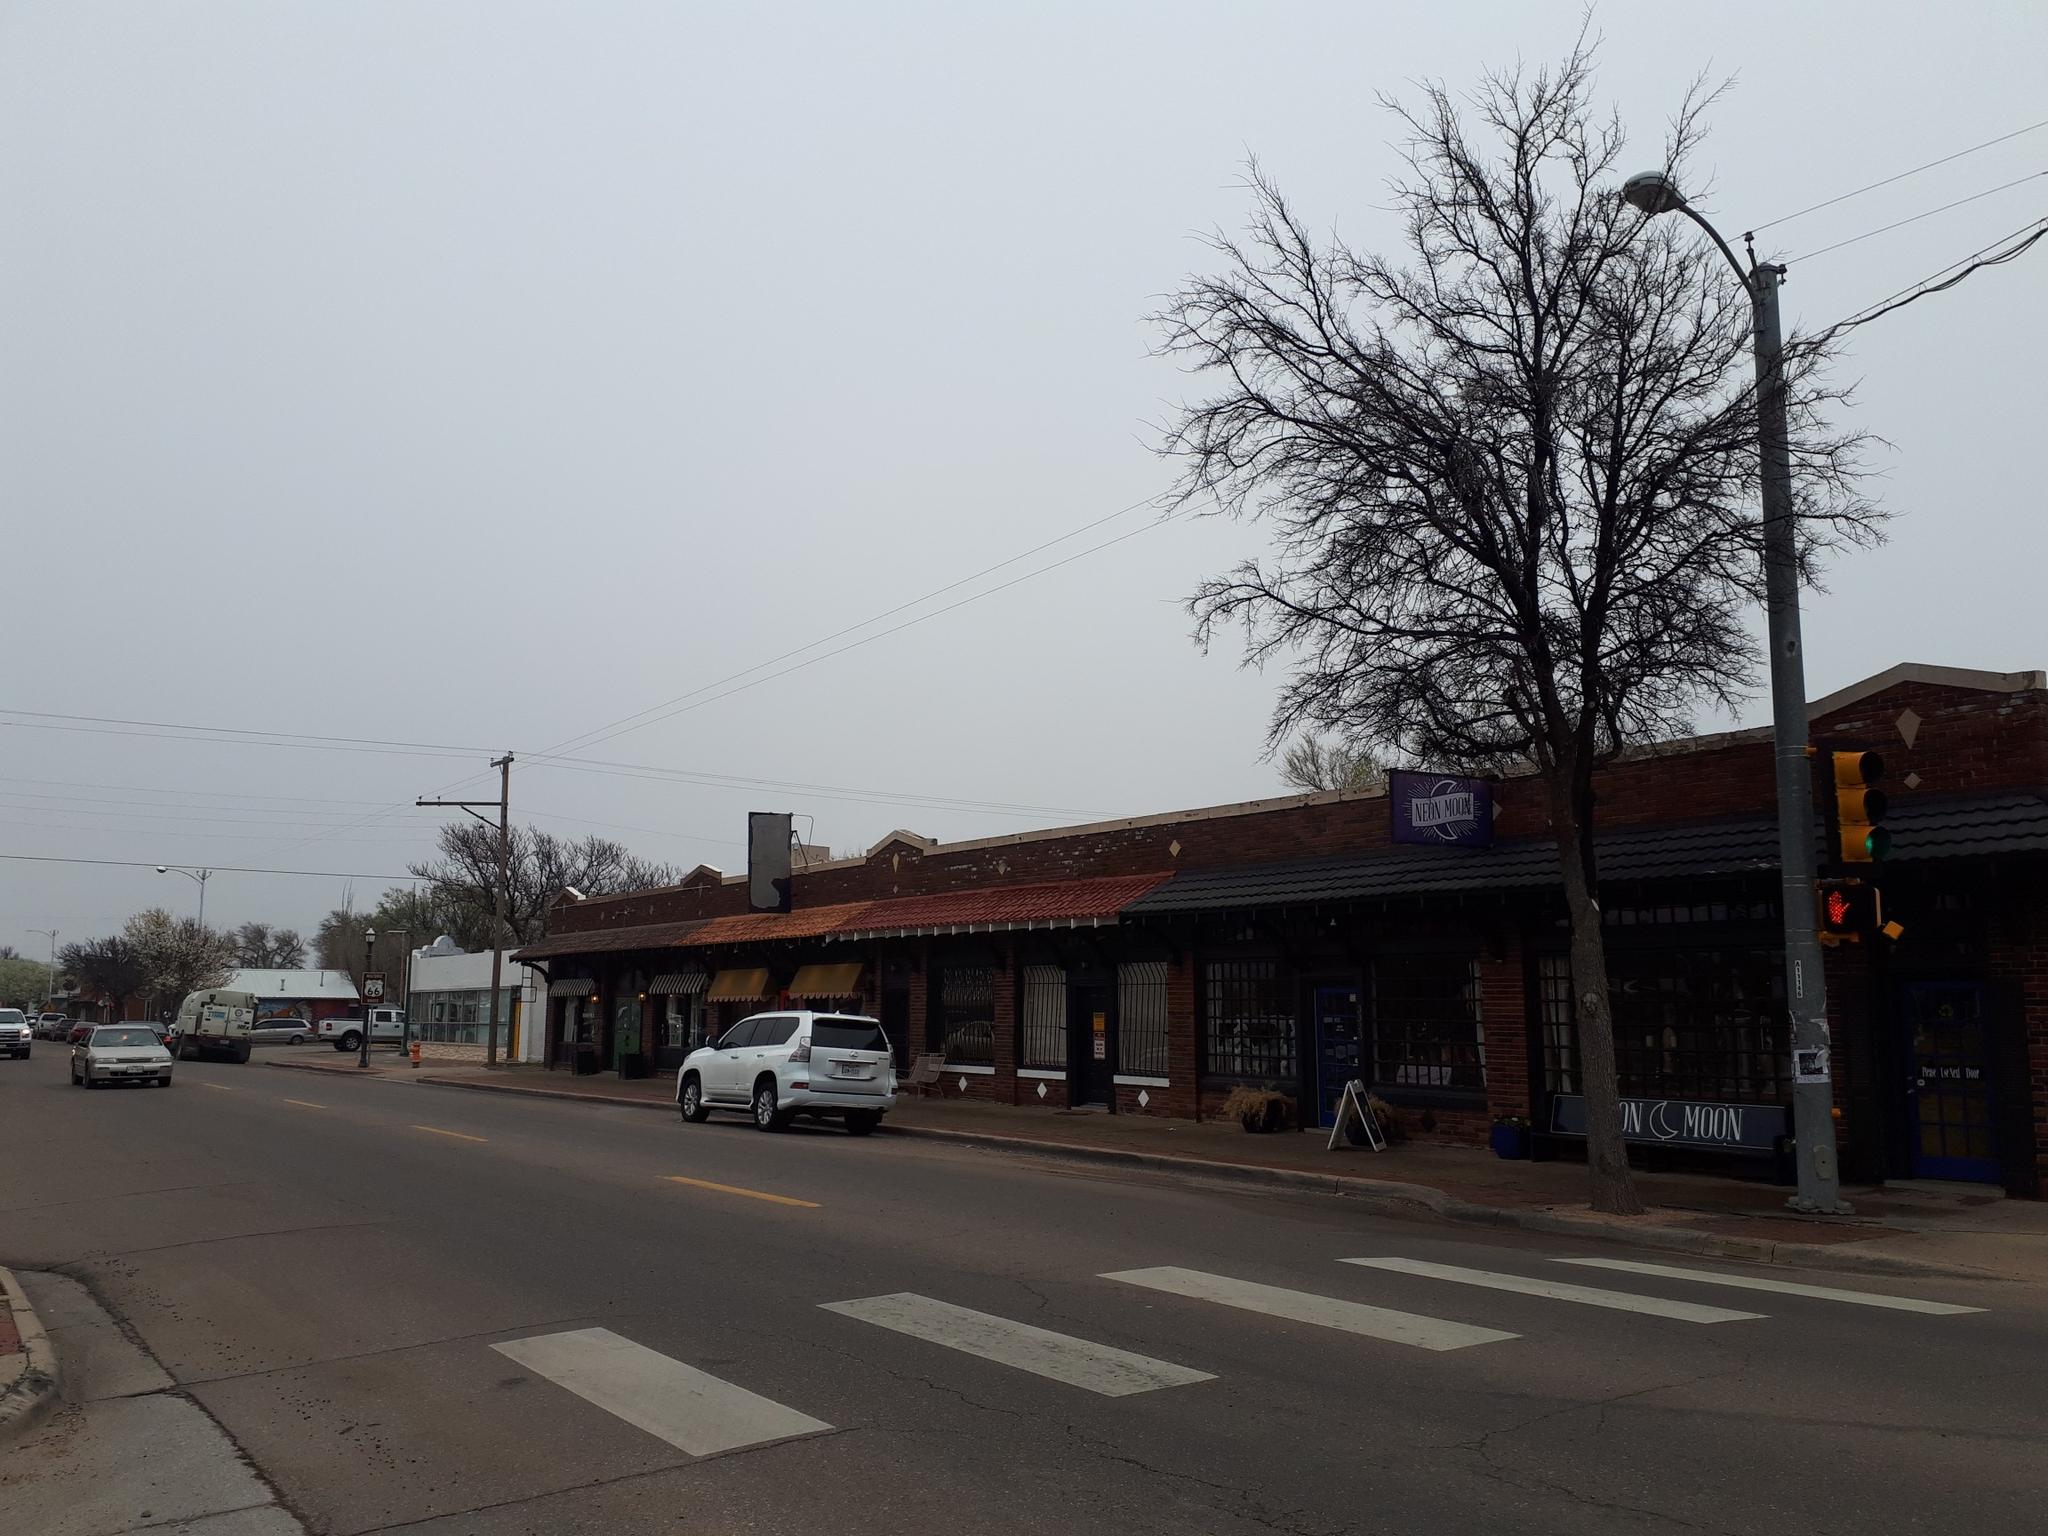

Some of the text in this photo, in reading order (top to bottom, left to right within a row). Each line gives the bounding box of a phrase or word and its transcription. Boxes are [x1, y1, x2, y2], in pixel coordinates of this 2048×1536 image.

[1415, 797, 1472, 822] NEON MOON
[367, 986, 380, 996] 66
[1619, 1101, 1743, 1141] ON MOON
